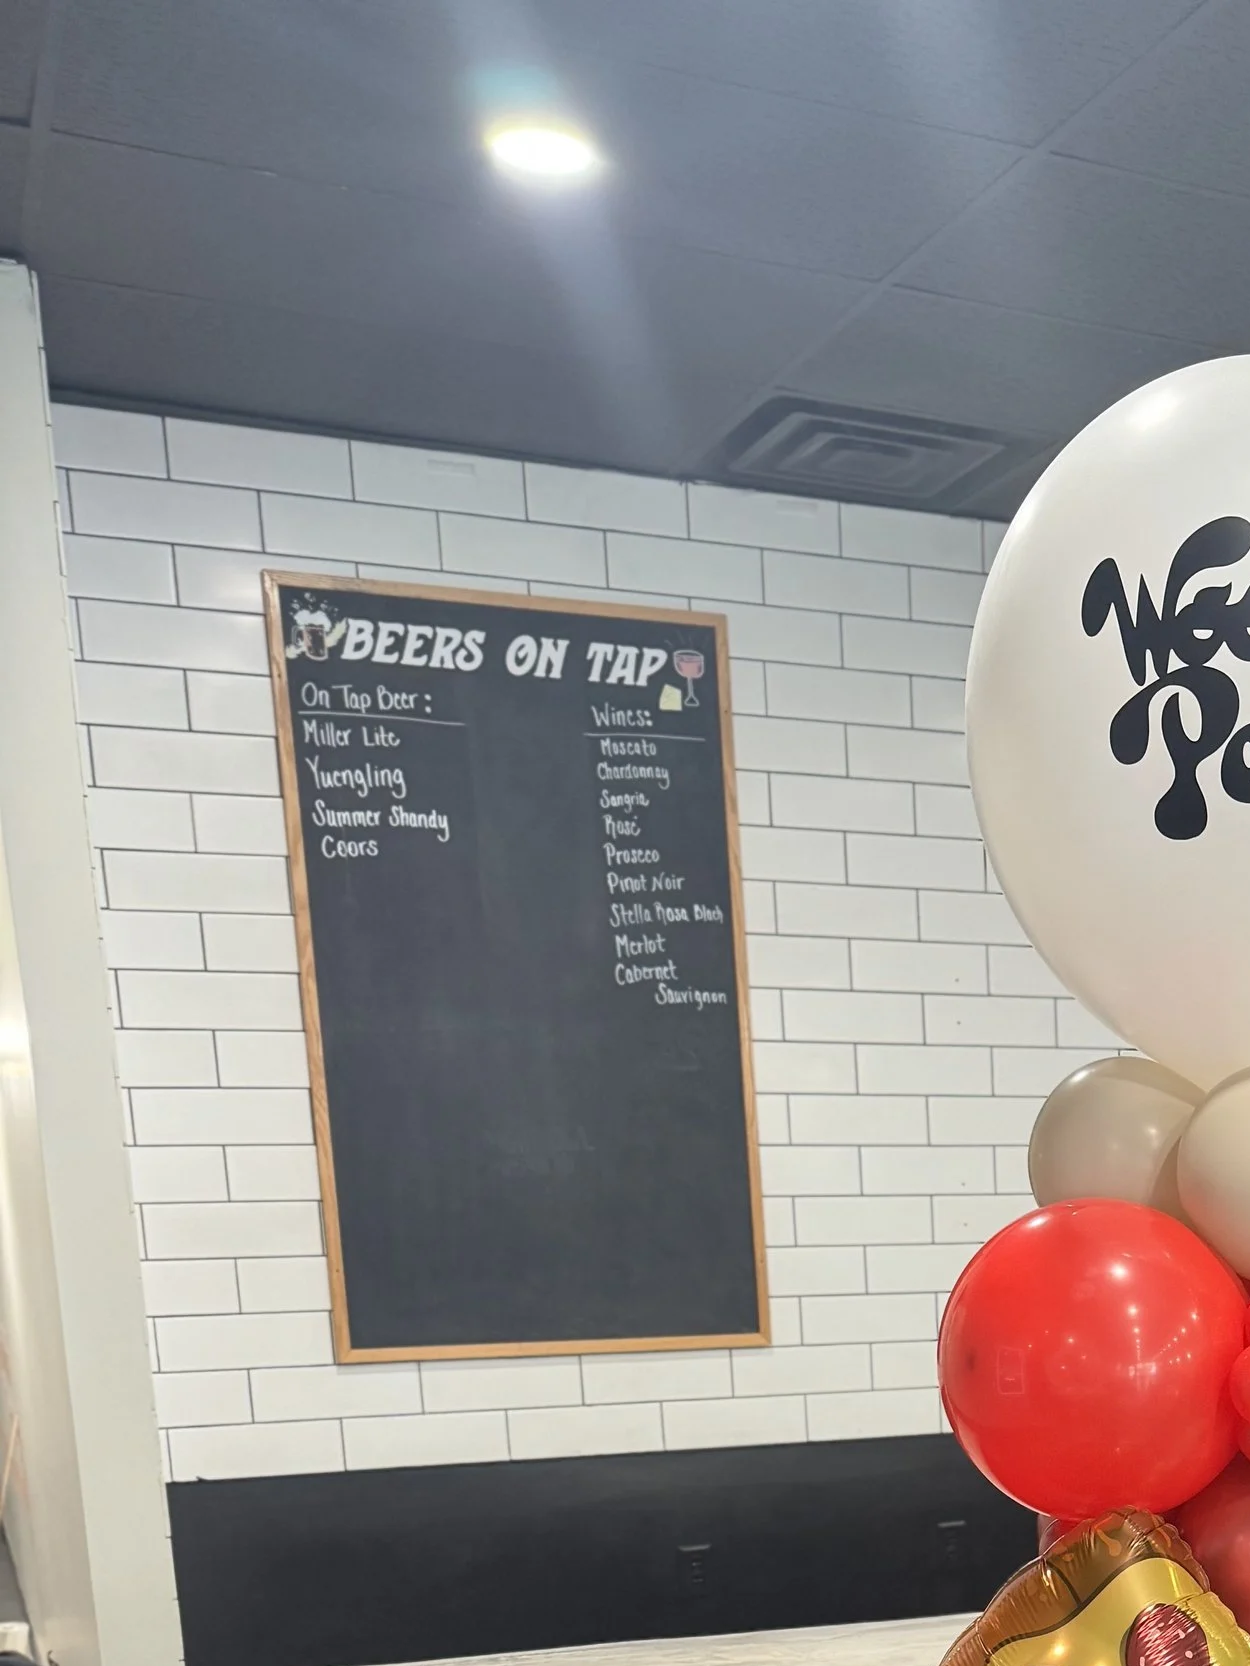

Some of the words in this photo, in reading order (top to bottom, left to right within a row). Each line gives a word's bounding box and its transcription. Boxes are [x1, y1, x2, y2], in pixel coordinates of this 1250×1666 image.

[340, 617, 487, 672] BEERS
[504, 634, 571, 679] ON
[585, 642, 669, 687] TAP
[301, 681, 330, 709] On
[331, 684, 372, 713] Tap
[591, 702, 653, 727] Wines:
[303, 719, 352, 747] Miller
[362, 725, 401, 747] Lite
[600, 737, 657, 757] Moscato
[305, 755, 407, 799] Yuengling
[597, 761, 670, 790] Chardonnay
[600, 788, 650, 813] Sangria
[312, 799, 381, 827] Summer
[388, 805, 450, 842] Shandy
[321, 835, 379, 859] Coors
[607, 871, 647, 894] Pinot
[651, 872, 686, 892] Noir
[609, 903, 652, 928] Stella
[653, 901, 690, 926] Rosa
[615, 933, 666, 958] Merlot
[615, 959, 679, 986] Cabernet
[654, 982, 727, 1011] Sauvignon
